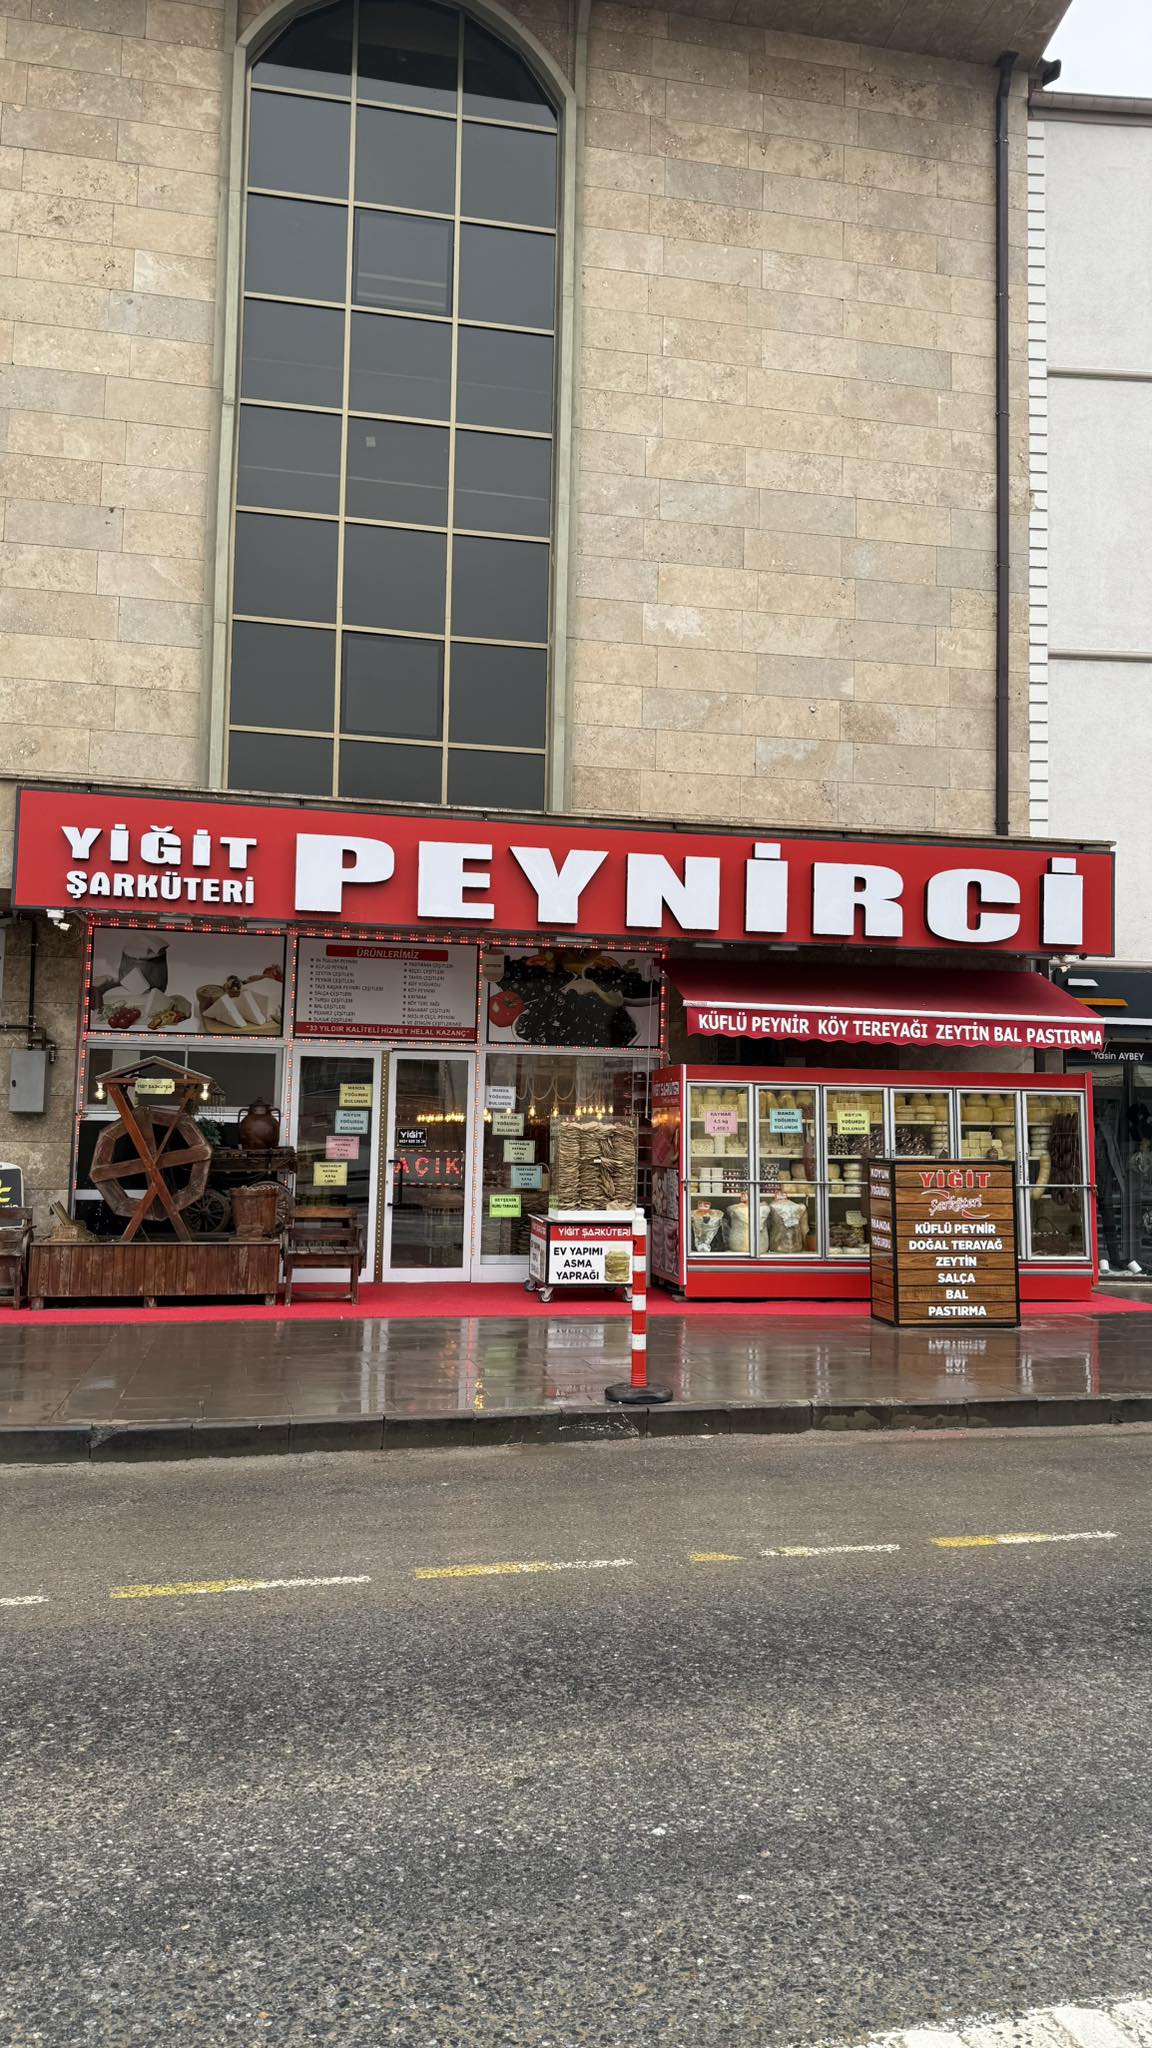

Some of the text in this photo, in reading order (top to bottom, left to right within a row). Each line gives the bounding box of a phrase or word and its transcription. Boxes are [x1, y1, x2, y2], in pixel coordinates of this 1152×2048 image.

[61, 824, 257, 869] YİĞİT
[66, 870, 254, 904] ŞARKÜTERİ
[294, 833, 1084, 945] PEYNİRCİ
[356, 948, 420, 960] ÜRÜNLERİMİZ
[346, 1026, 380, 1034] KALİTELİ
[380, 1027, 409, 1035] HİZMET
[410, 1028, 434, 1036] HELAL
[698, 1012, 1102, 1045] KÜFLÜ PEYNİR KÖY TEREYAĞI ZEYTİN BAL PASTIRMA
[1093, 1051, 1144, 1061] Yasin AYBEY
[400, 1130, 424, 1138] YİĞİT
[394, 1157, 460, 1178] AÇIK
[918, 1169, 991, 1188] YİĞİT
[929, 1195, 983, 1216] Şarküteri
[558, 1226, 580, 1236] YİĞİT
[582, 1226, 631, 1238] ŞARKÜTERİ
[915, 1222, 996, 1234] KÜFLÜ PEYNİR
[908, 1238, 1003, 1250] DOĞAL TERAYAĞ
[554, 1247, 603, 1256] EV YAPIMI
[564, 1260, 592, 1268] ASMA
[936, 1254, 977, 1266] ZEYTİN
[556, 1270, 600, 1280] YAPRAĞI
[938, 1273, 976, 1285] SALÇA
[946, 1290, 968, 1300] BAL
[928, 1306, 987, 1316] PASTIRMA
